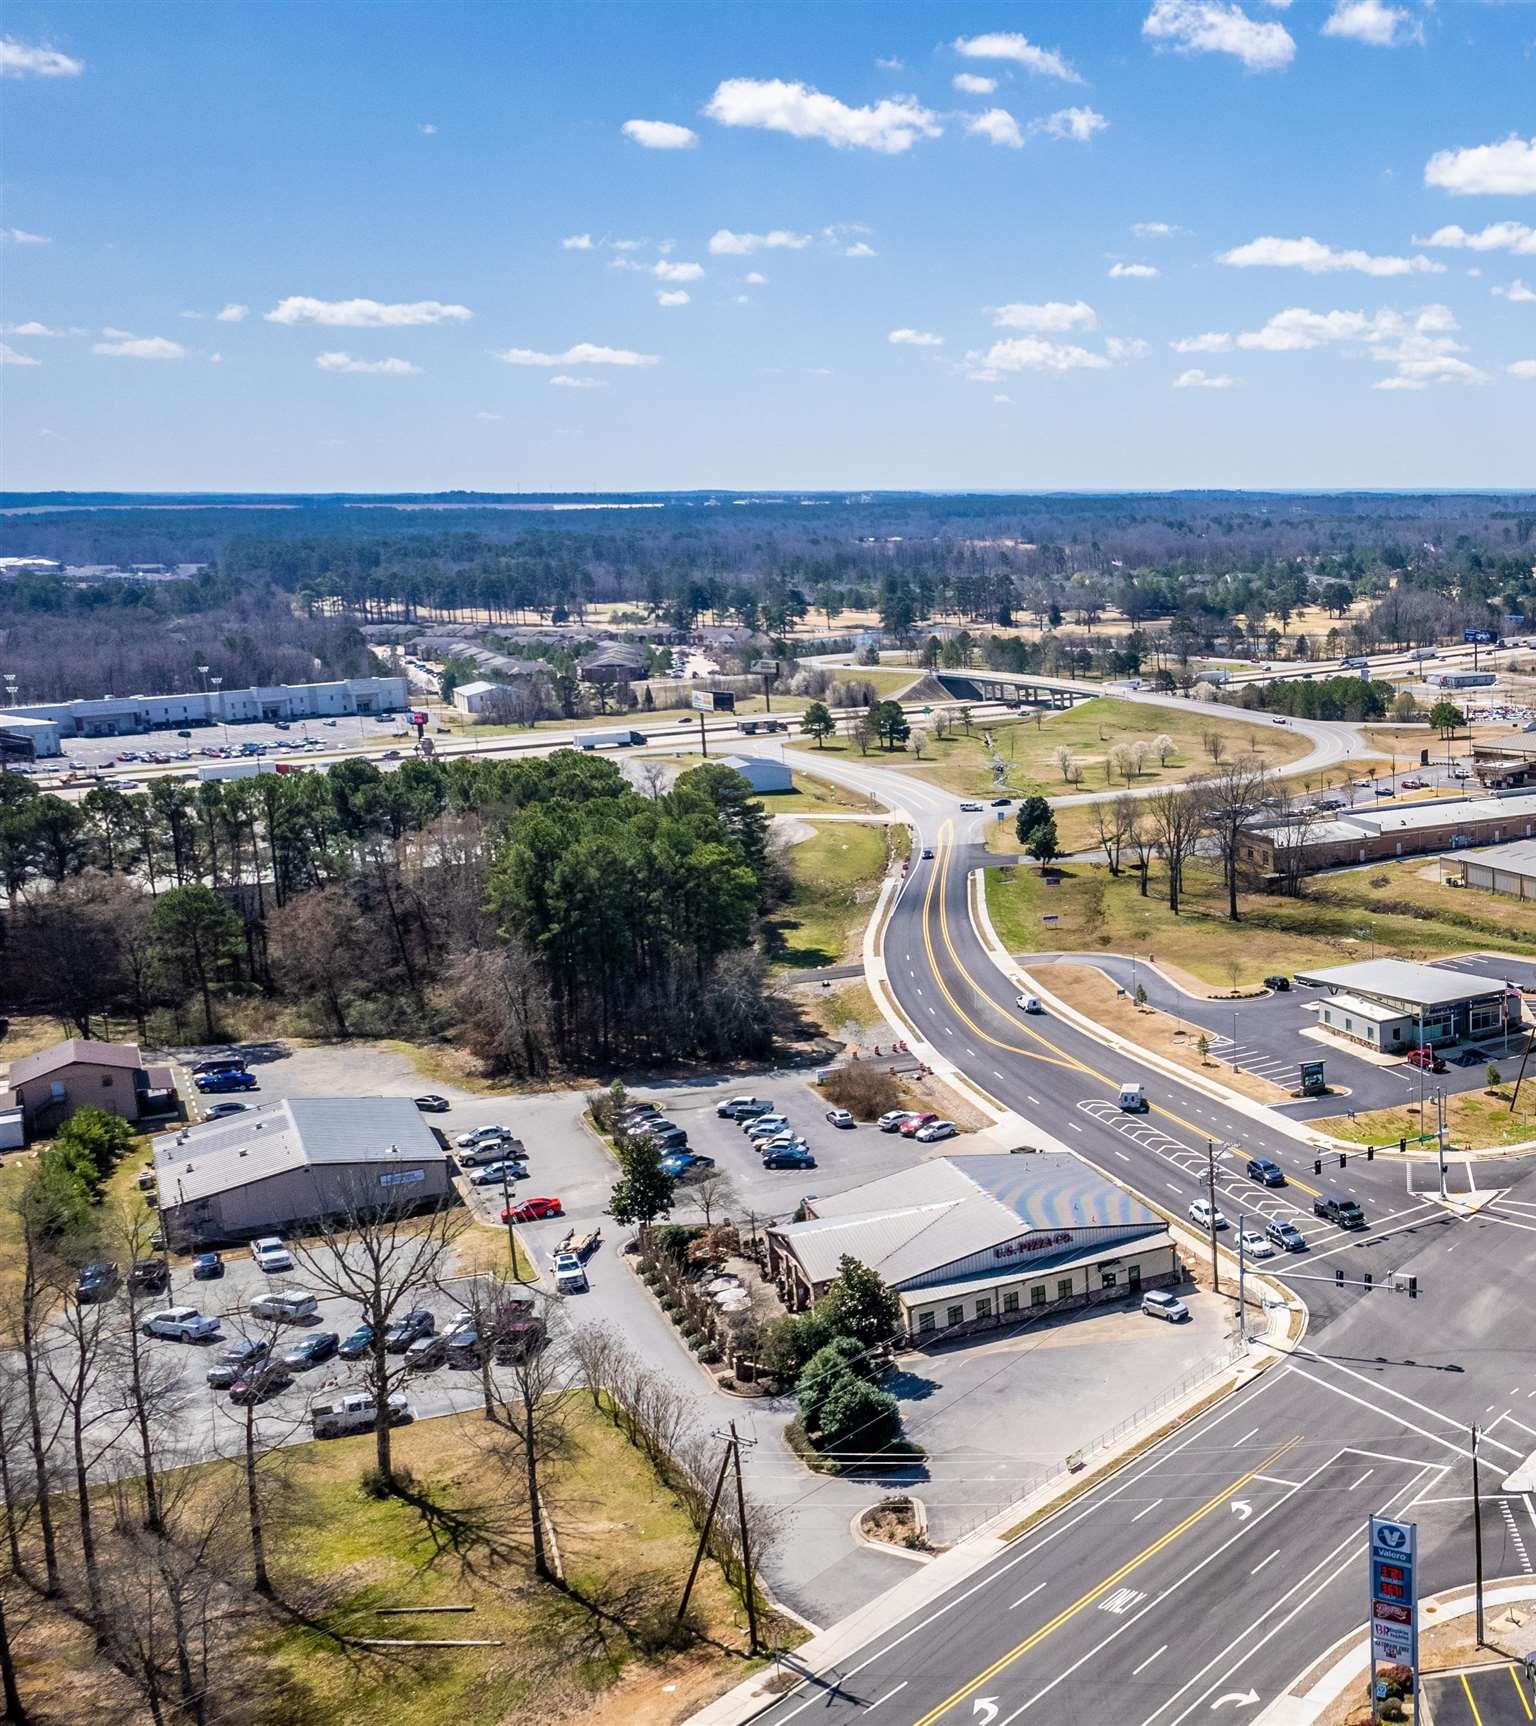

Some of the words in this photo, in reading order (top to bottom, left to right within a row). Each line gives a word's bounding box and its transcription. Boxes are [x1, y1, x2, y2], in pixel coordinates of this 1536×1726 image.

[994, 1246, 1017, 1258] U.S.
[1018, 1237, 1053, 1253] PIZZA
[1378, 1548, 1407, 1561] Valero
[1097, 1588, 1148, 1614] ONLY
